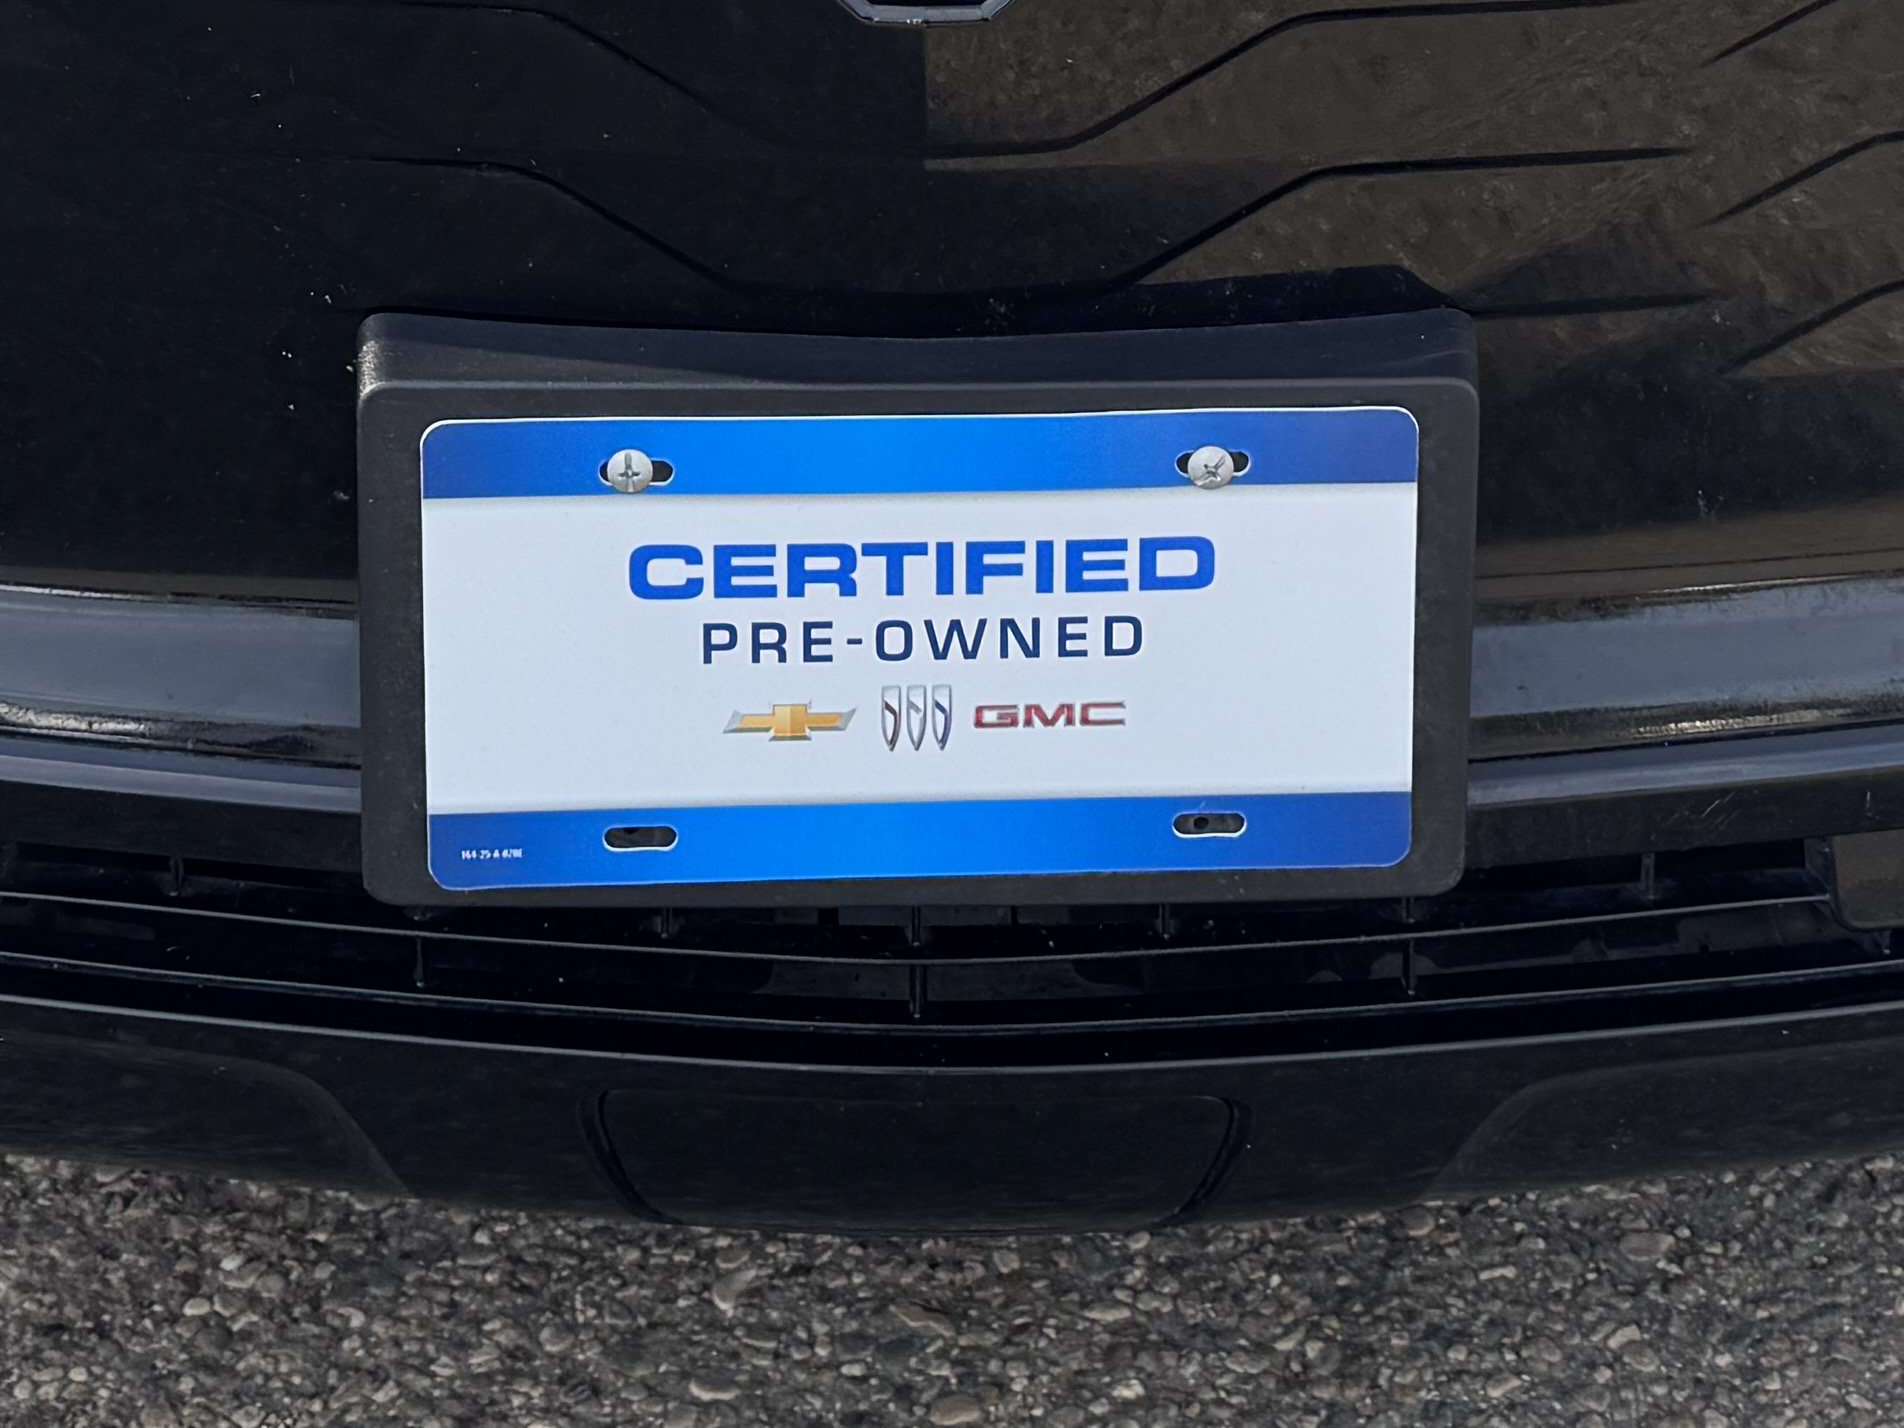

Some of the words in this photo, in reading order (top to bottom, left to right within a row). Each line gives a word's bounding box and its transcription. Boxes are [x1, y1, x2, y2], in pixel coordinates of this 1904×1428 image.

[628, 536, 1215, 601] CERTIFIED
[702, 617, 1144, 664] PRE-OWNED
[974, 701, 1126, 731] GMC
